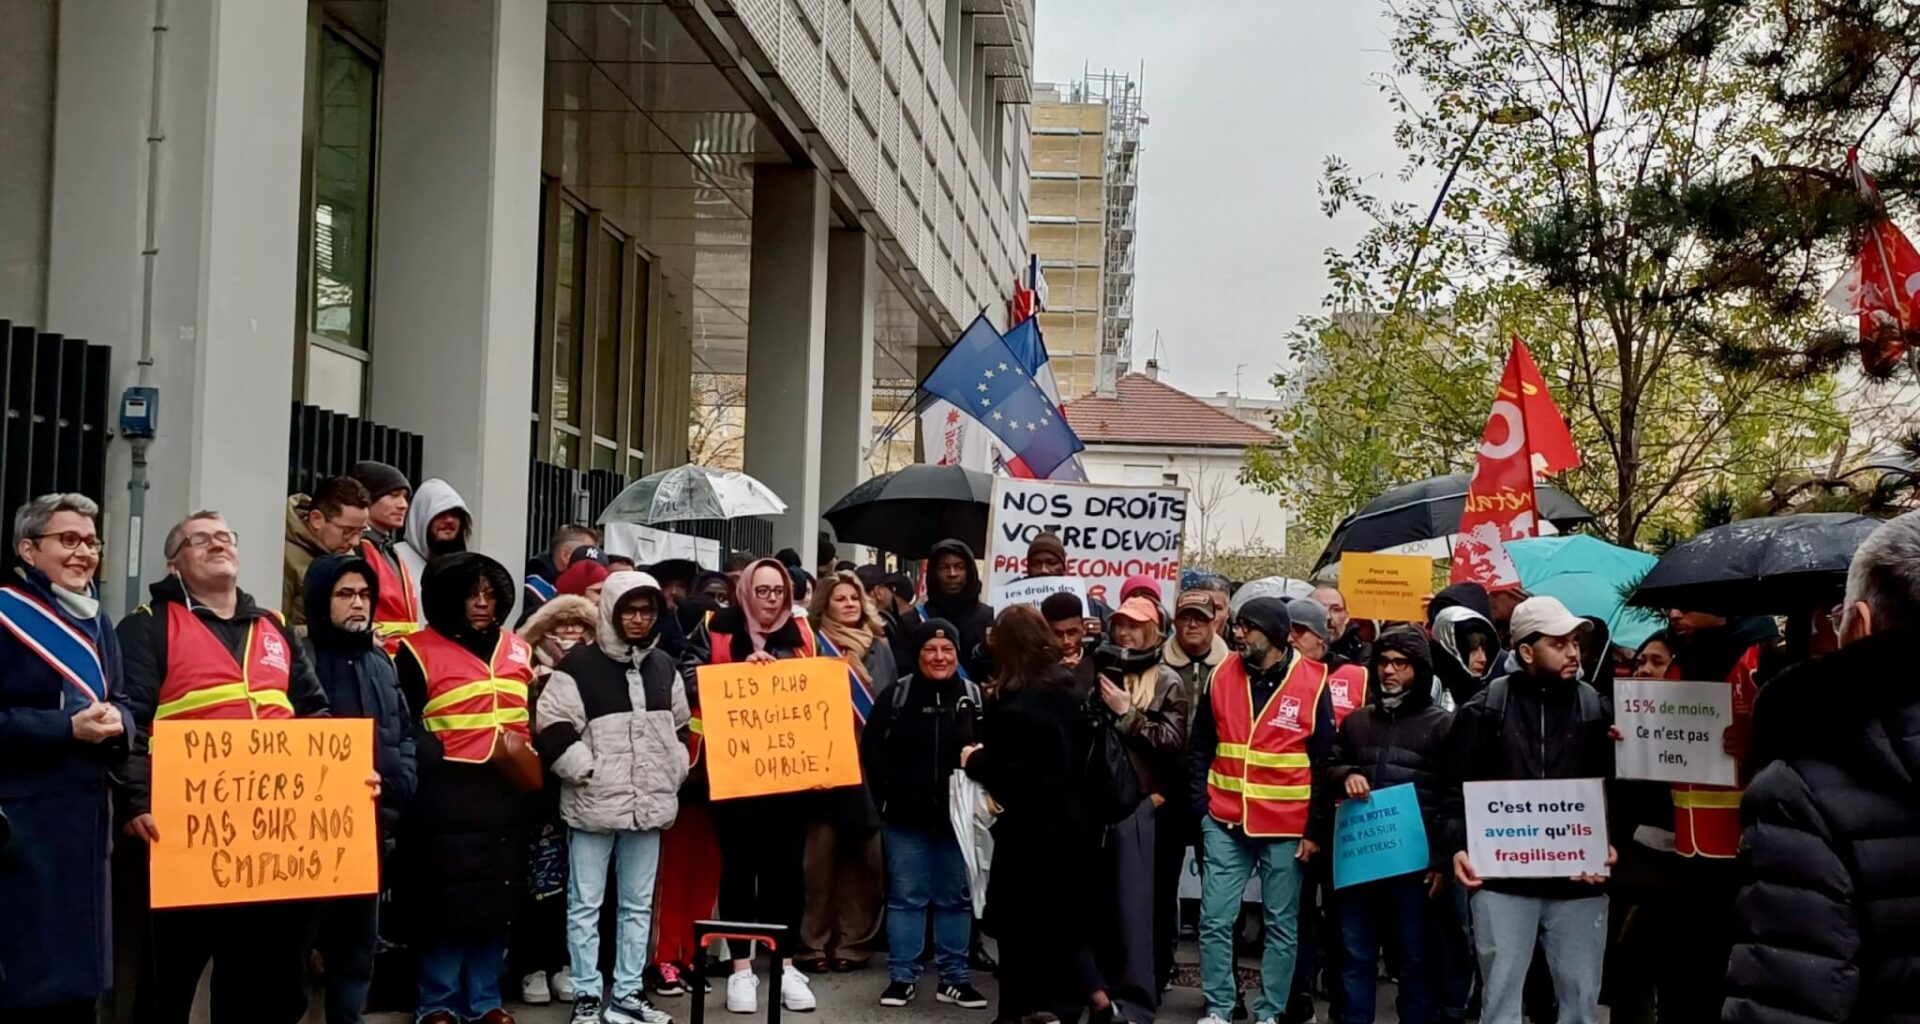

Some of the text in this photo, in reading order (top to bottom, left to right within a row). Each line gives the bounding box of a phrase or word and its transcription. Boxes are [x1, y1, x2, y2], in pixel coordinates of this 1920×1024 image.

[1003, 492, 1072, 518] NOS
[1024, 585, 1055, 596] droits
[724, 677, 759, 699] LES
[1659, 701, 1675, 714] de
[1678, 702, 1720, 719] moins,
[1636, 725, 1649, 739] Ce
[1688, 731, 1709, 744] pas
[184, 729, 352, 763] PAS SUR NOS
[728, 732, 795, 758] ON LES
[1658, 750, 1688, 767] rien,
[1538, 801, 1585, 813] notre
[187, 805, 353, 848] PAS SUR NOS
[1376, 823, 1398, 835] SUR
[1485, 825, 1540, 838] avenir
[1495, 849, 1586, 864] fragilisent
